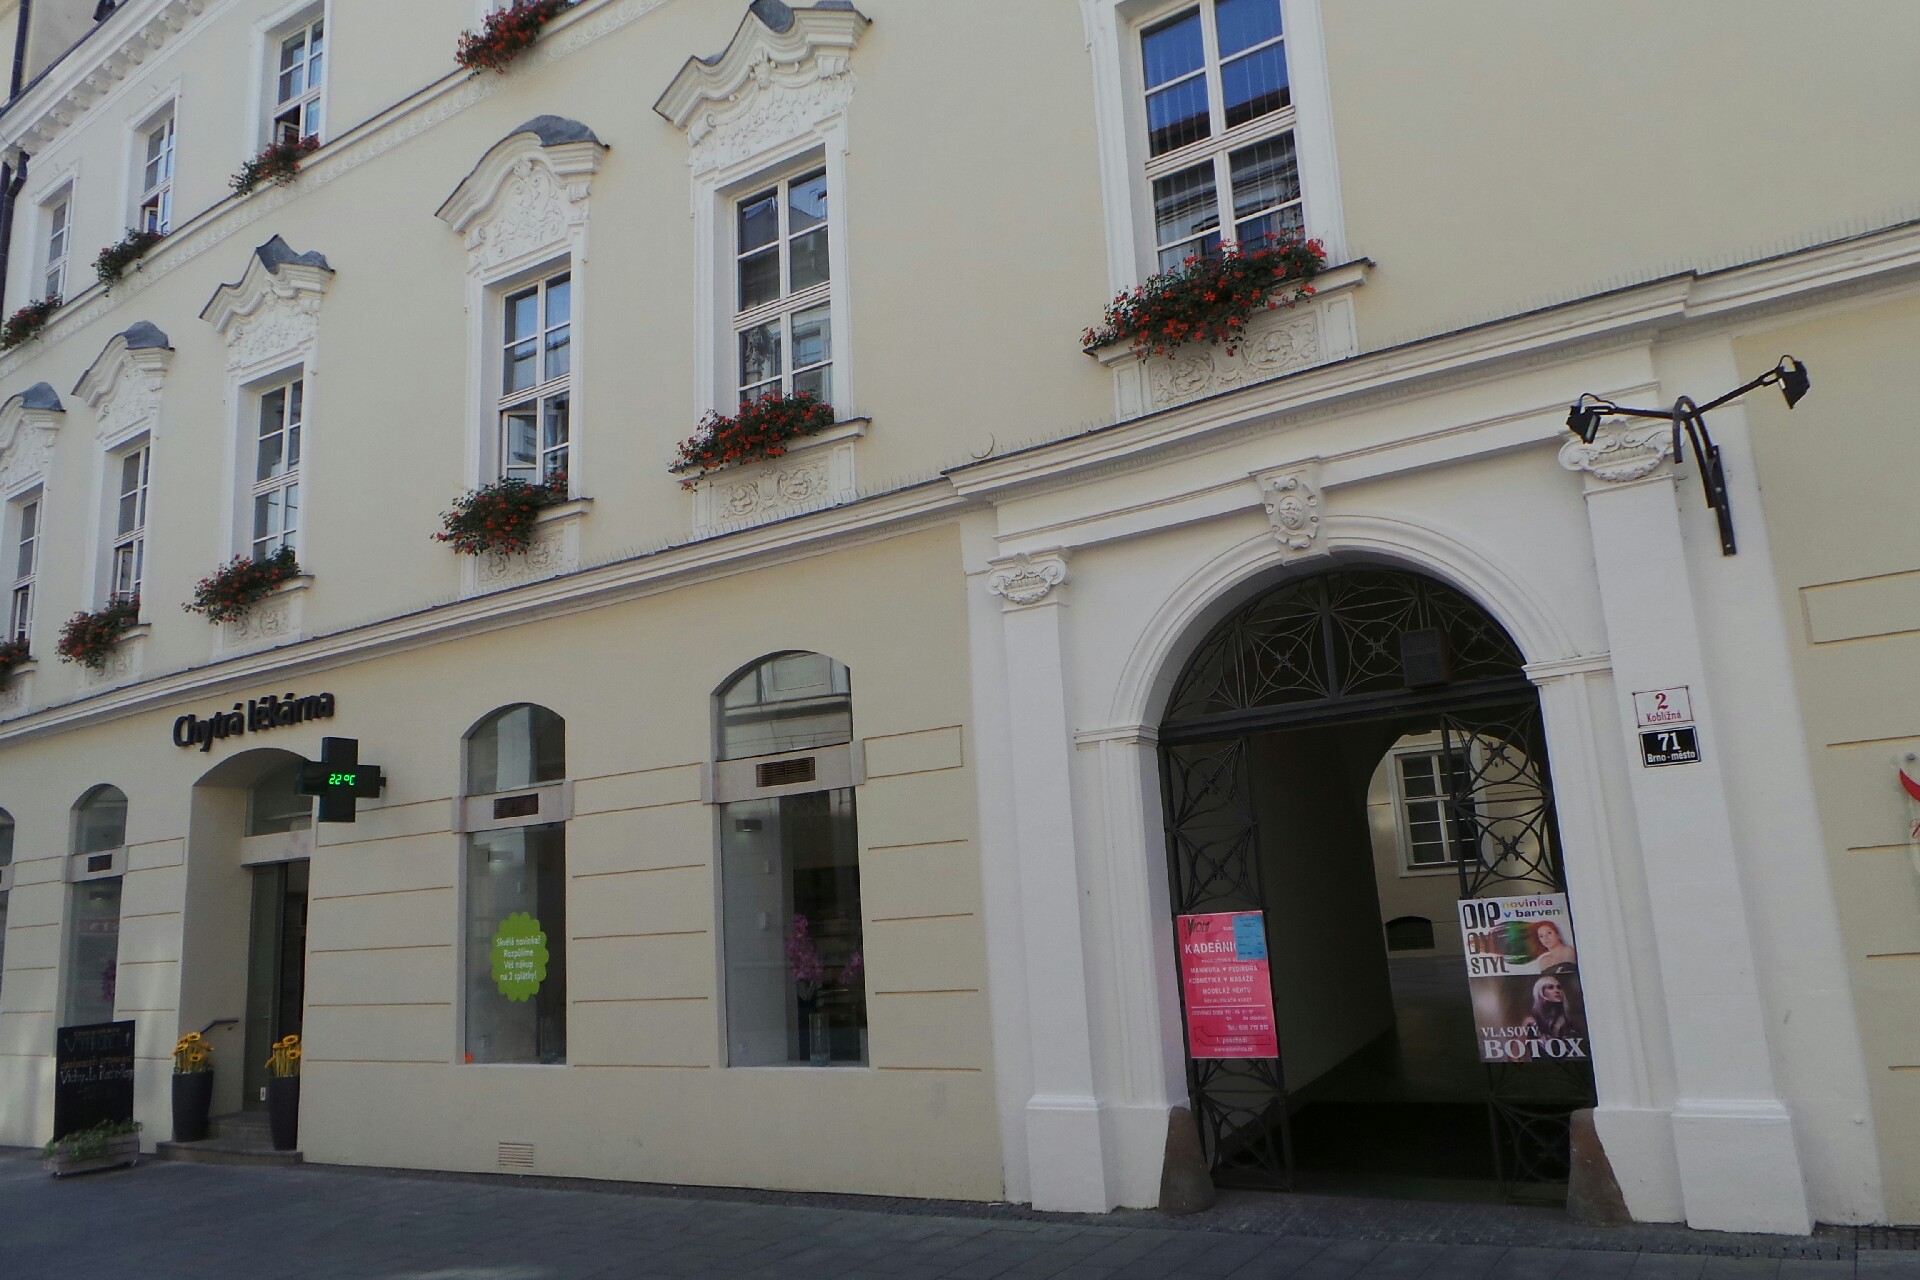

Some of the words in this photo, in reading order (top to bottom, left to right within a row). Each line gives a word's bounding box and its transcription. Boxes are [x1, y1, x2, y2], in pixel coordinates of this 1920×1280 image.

[1655, 693, 1668, 710] 2
[173, 703, 244, 752] Chytrá
[247, 692, 335, 732] lékárna
[1646, 710, 1682, 722] Kobližná
[1657, 732, 1681, 751] 71
[1502, 899, 1553, 908] novinka
[1462, 902, 1500, 929] DIP
[1481, 1023, 1539, 1038] VLASOVÝ
[1483, 1037, 1587, 1059] BOTOX
